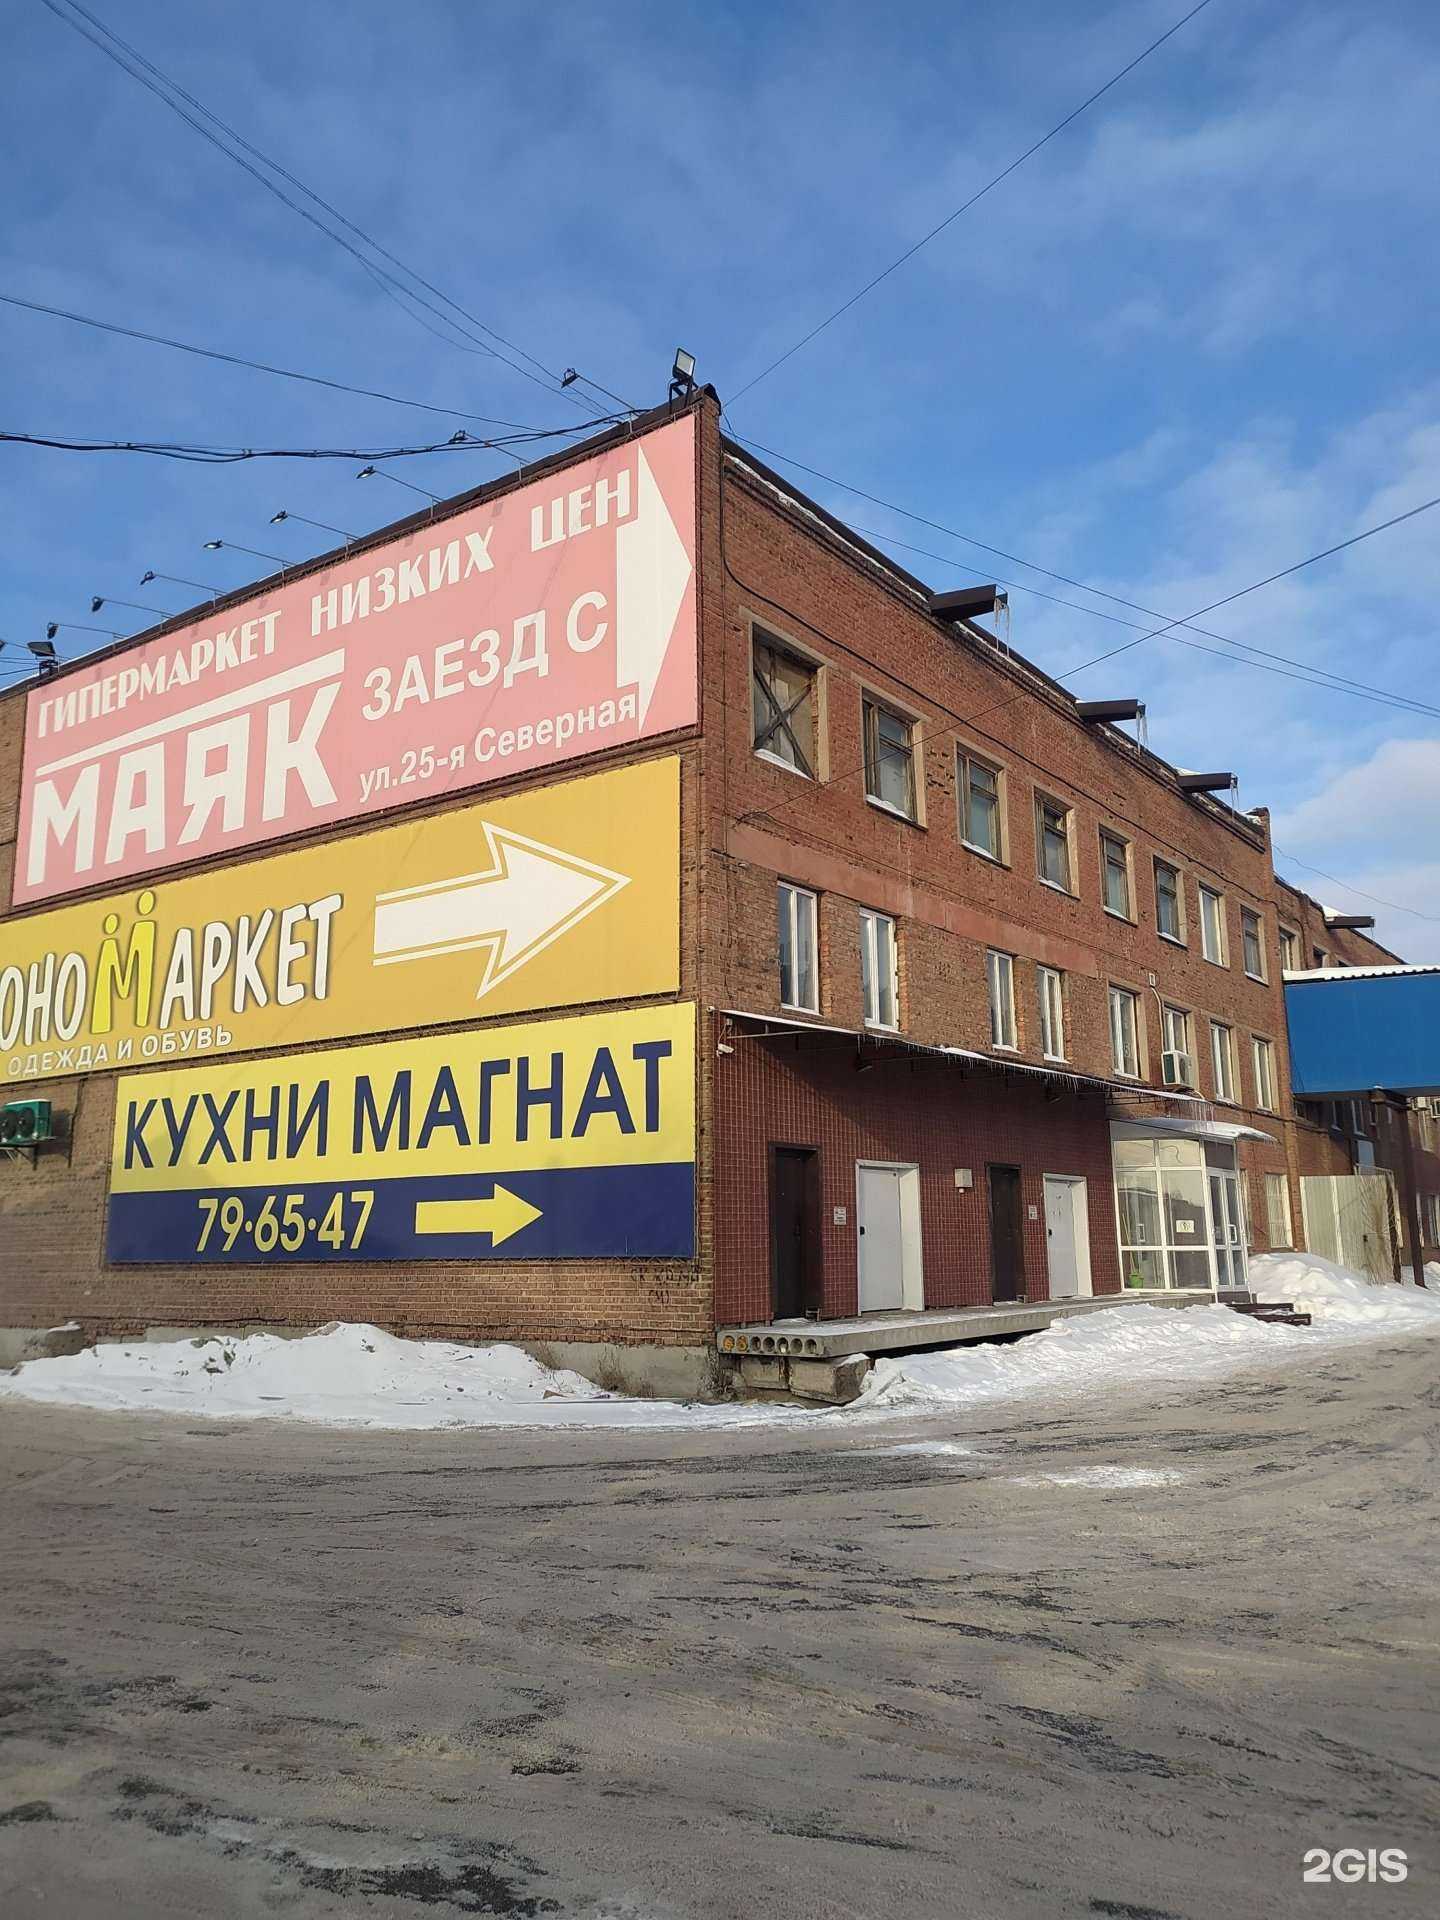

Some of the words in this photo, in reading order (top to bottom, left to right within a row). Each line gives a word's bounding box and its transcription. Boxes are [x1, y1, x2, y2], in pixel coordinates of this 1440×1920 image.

[38, 610, 281, 738] ГИПЕРМАРКЕТ
[311, 526, 494, 637] НИЗКИХ
[531, 469, 630, 552] ЦЕН
[362, 610, 549, 721] ЗАЕЗД
[566, 591, 608, 653] С
[26, 682, 342, 887] МАЯК
[474, 693, 636, 762] Северная
[8, 1043, 108, 1076] ОДЕЖДА
[117, 1039, 132, 1060] И
[141, 1024, 232, 1058] ОБУВЬ
[124, 1080, 330, 1170] КУХНИ
[352, 1040, 672, 1155] МАГНАТ
